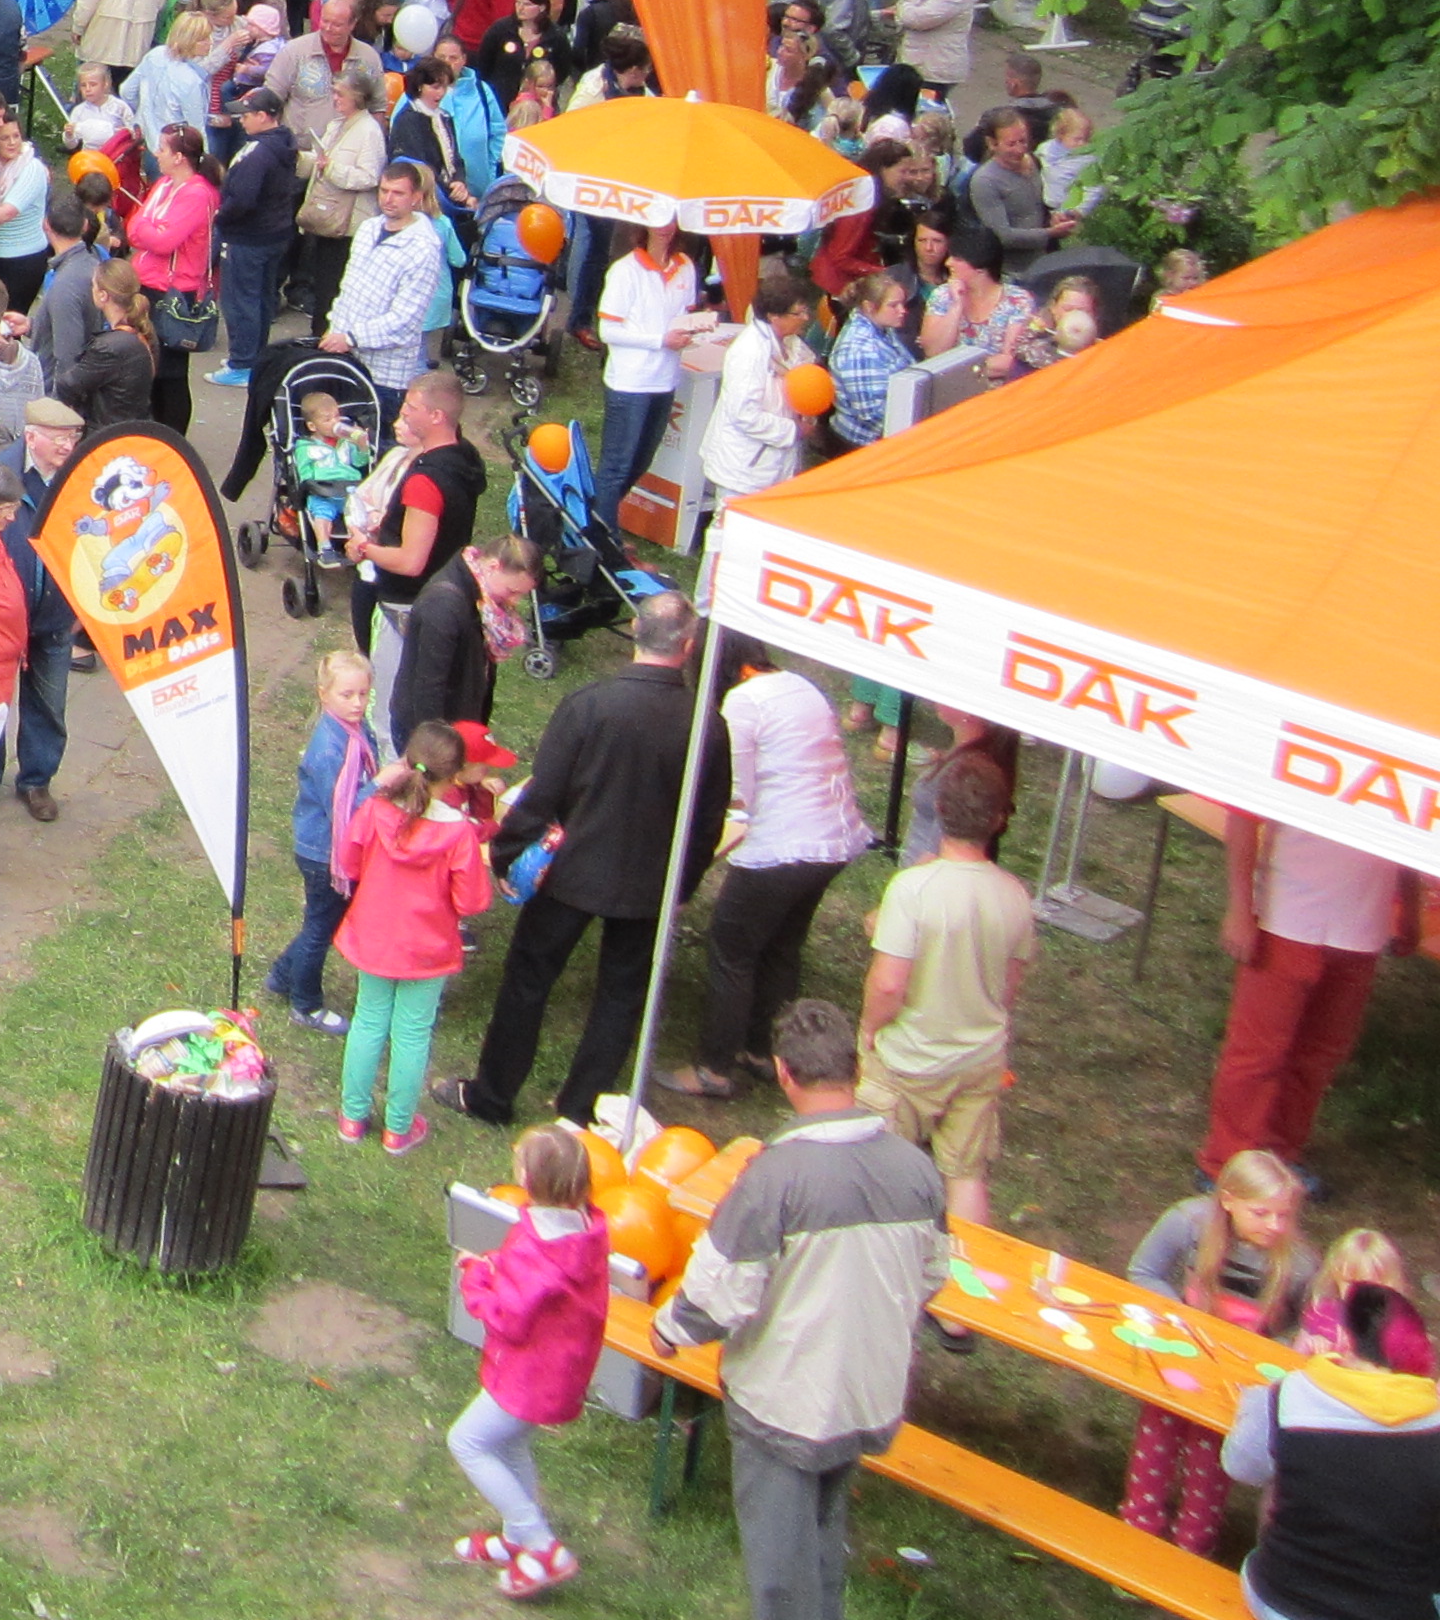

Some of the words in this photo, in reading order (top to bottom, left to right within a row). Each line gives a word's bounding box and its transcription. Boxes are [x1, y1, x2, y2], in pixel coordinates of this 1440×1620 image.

[573, 177, 654, 220] DAK
[702, 199, 784, 229] DAK
[821, 181, 856, 217] DAK
[756, 550, 934, 661] DAK
[123, 602, 218, 661] MAX
[125, 652, 164, 679] DER
[151, 675, 199, 706] DAK
[1000, 630, 1198, 750] DAK
